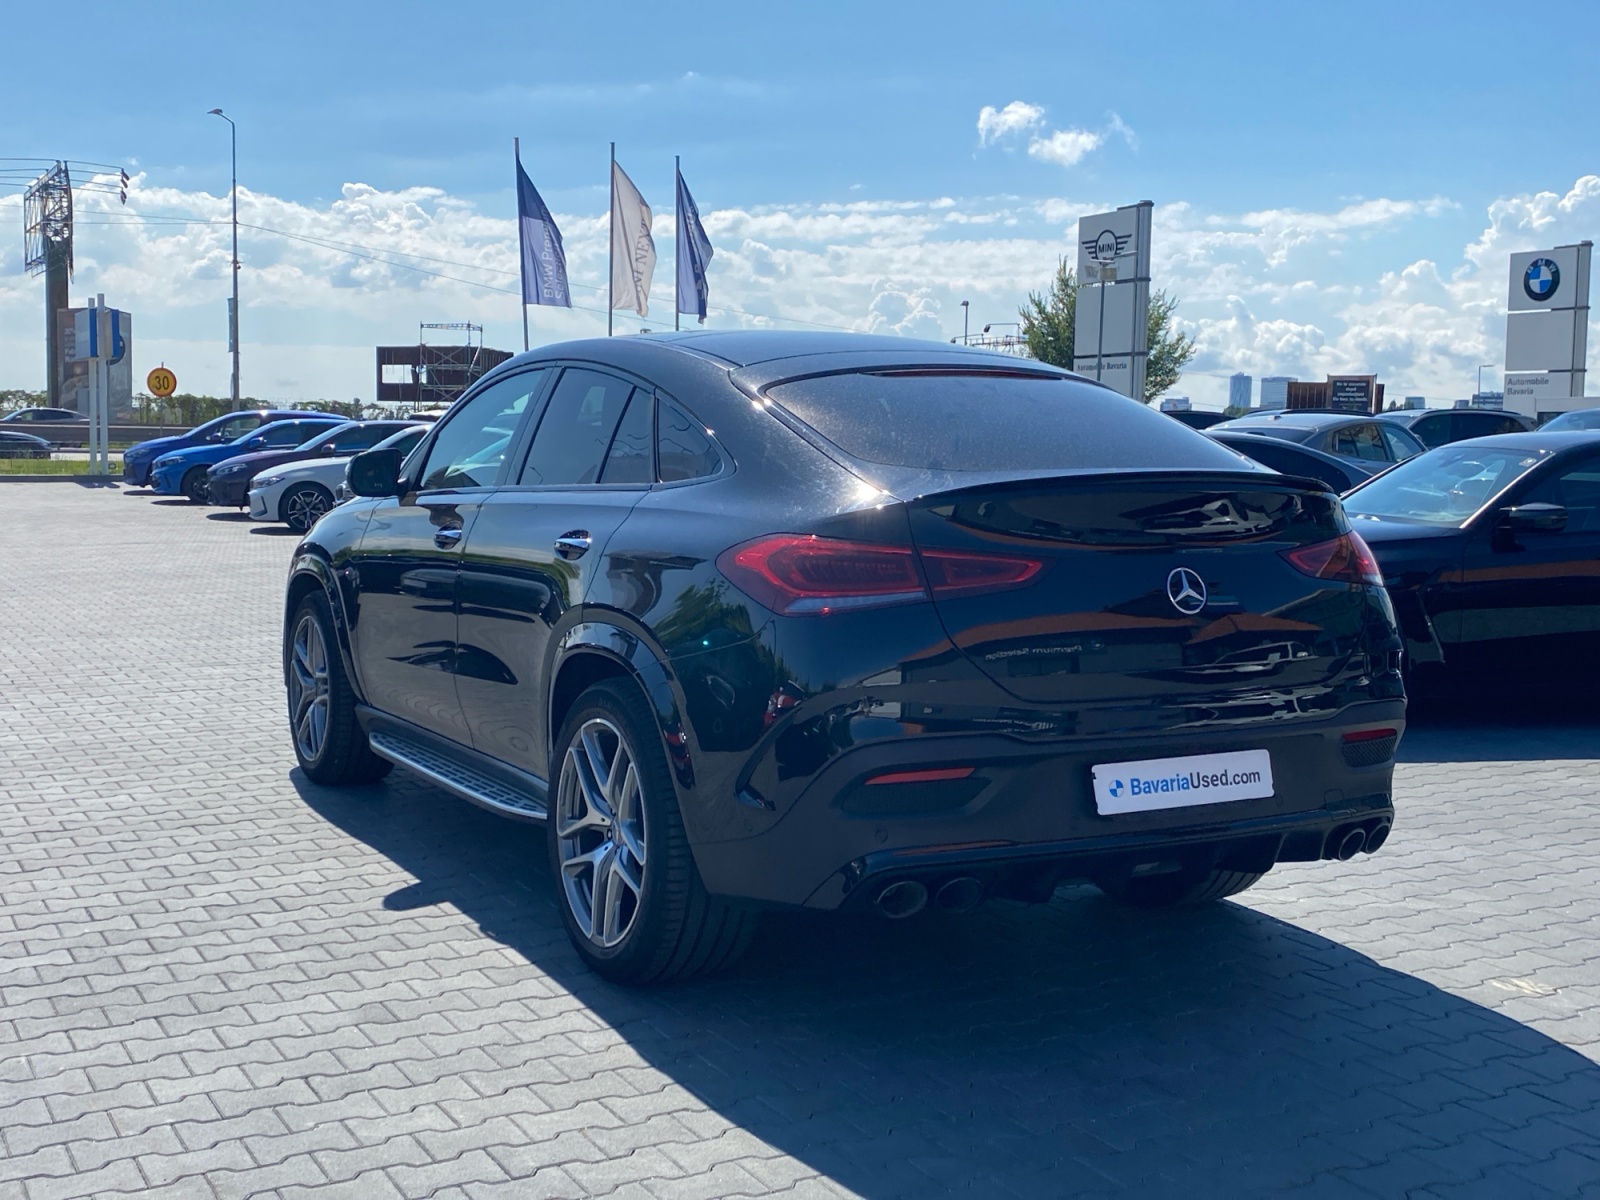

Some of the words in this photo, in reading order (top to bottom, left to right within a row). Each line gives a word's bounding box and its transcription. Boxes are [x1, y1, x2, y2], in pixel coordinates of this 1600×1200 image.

[1098, 243, 1115, 253] MINI
[1527, 259, 1557, 273] BMW
[543, 263, 554, 298] BMW
[1077, 362, 1106, 371] Automole
[1107, 361, 1127, 370] Bavaria
[155, 375, 170, 390] 30
[1507, 377, 1549, 385] Automobile
[1507, 387, 1534, 395] Bavaria
[1130, 769, 1261, 796] BavariaUsed.com
